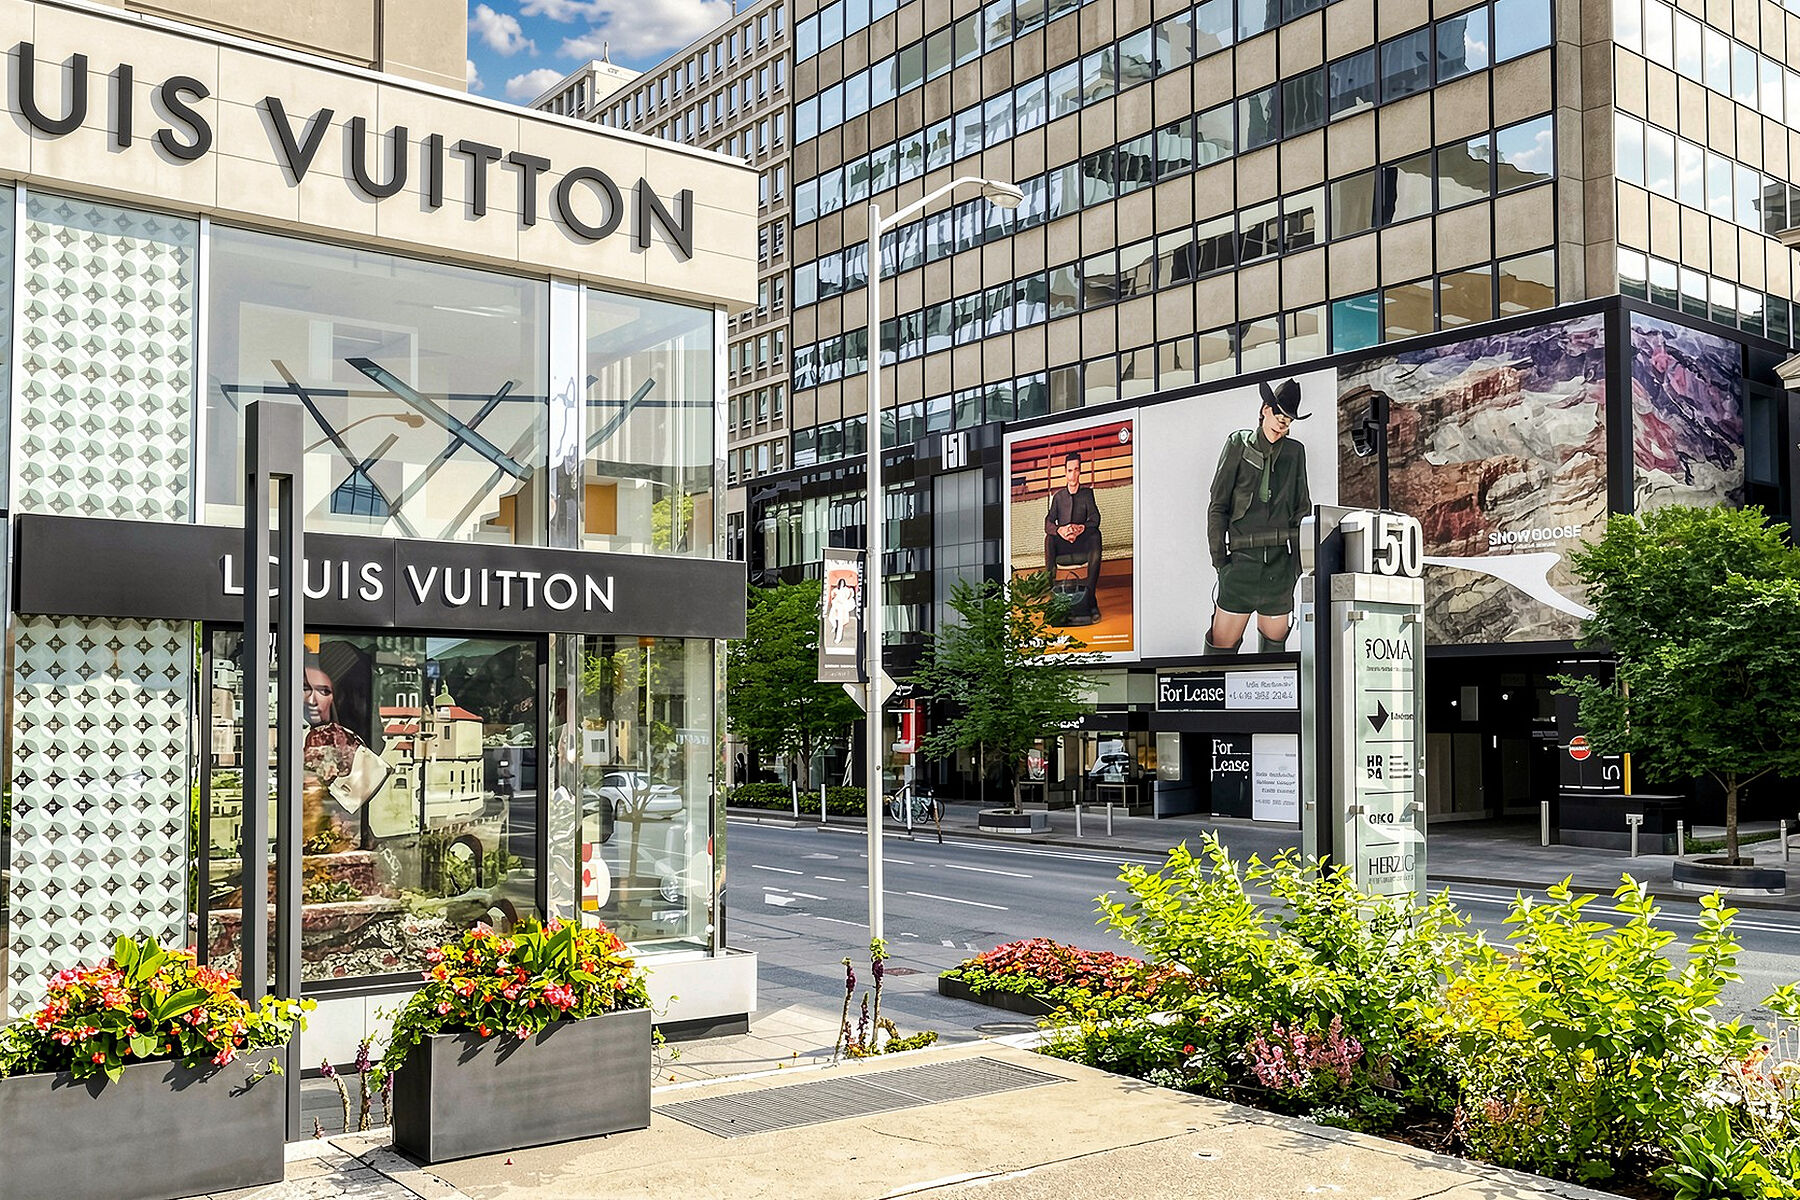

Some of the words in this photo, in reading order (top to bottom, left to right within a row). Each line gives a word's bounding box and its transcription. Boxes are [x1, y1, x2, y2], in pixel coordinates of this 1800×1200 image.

[262, 95, 694, 260] VUITTON
[941, 431, 968, 470] 151
[1340, 510, 1424, 578] 150
[224, 554, 384, 602] LUIS
[406, 564, 614, 613] VUITTON
[1159, 684, 1183, 702] For
[1183, 684, 1225, 702] Lease
[1211, 739, 1234, 755] For
[1211, 755, 1250, 772] Lease
[1368, 853, 1415, 876] HERZIG
